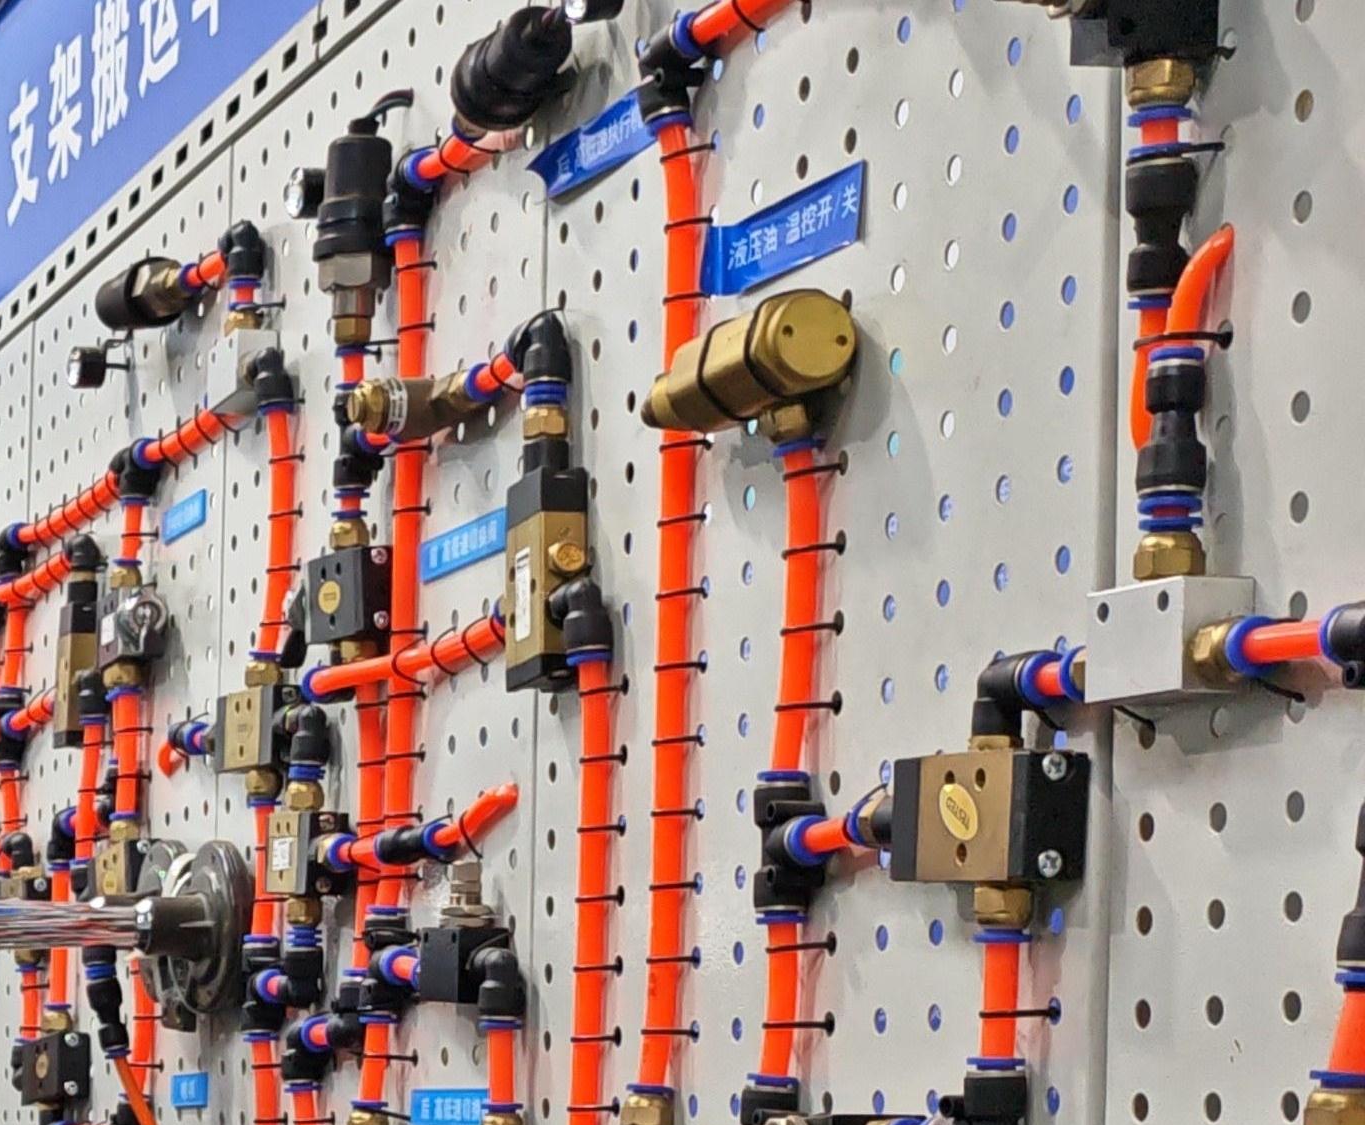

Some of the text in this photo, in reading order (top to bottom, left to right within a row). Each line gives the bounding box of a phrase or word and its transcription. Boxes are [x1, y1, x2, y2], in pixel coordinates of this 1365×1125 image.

[727, 183, 858, 270] 液压油 温控开/关
